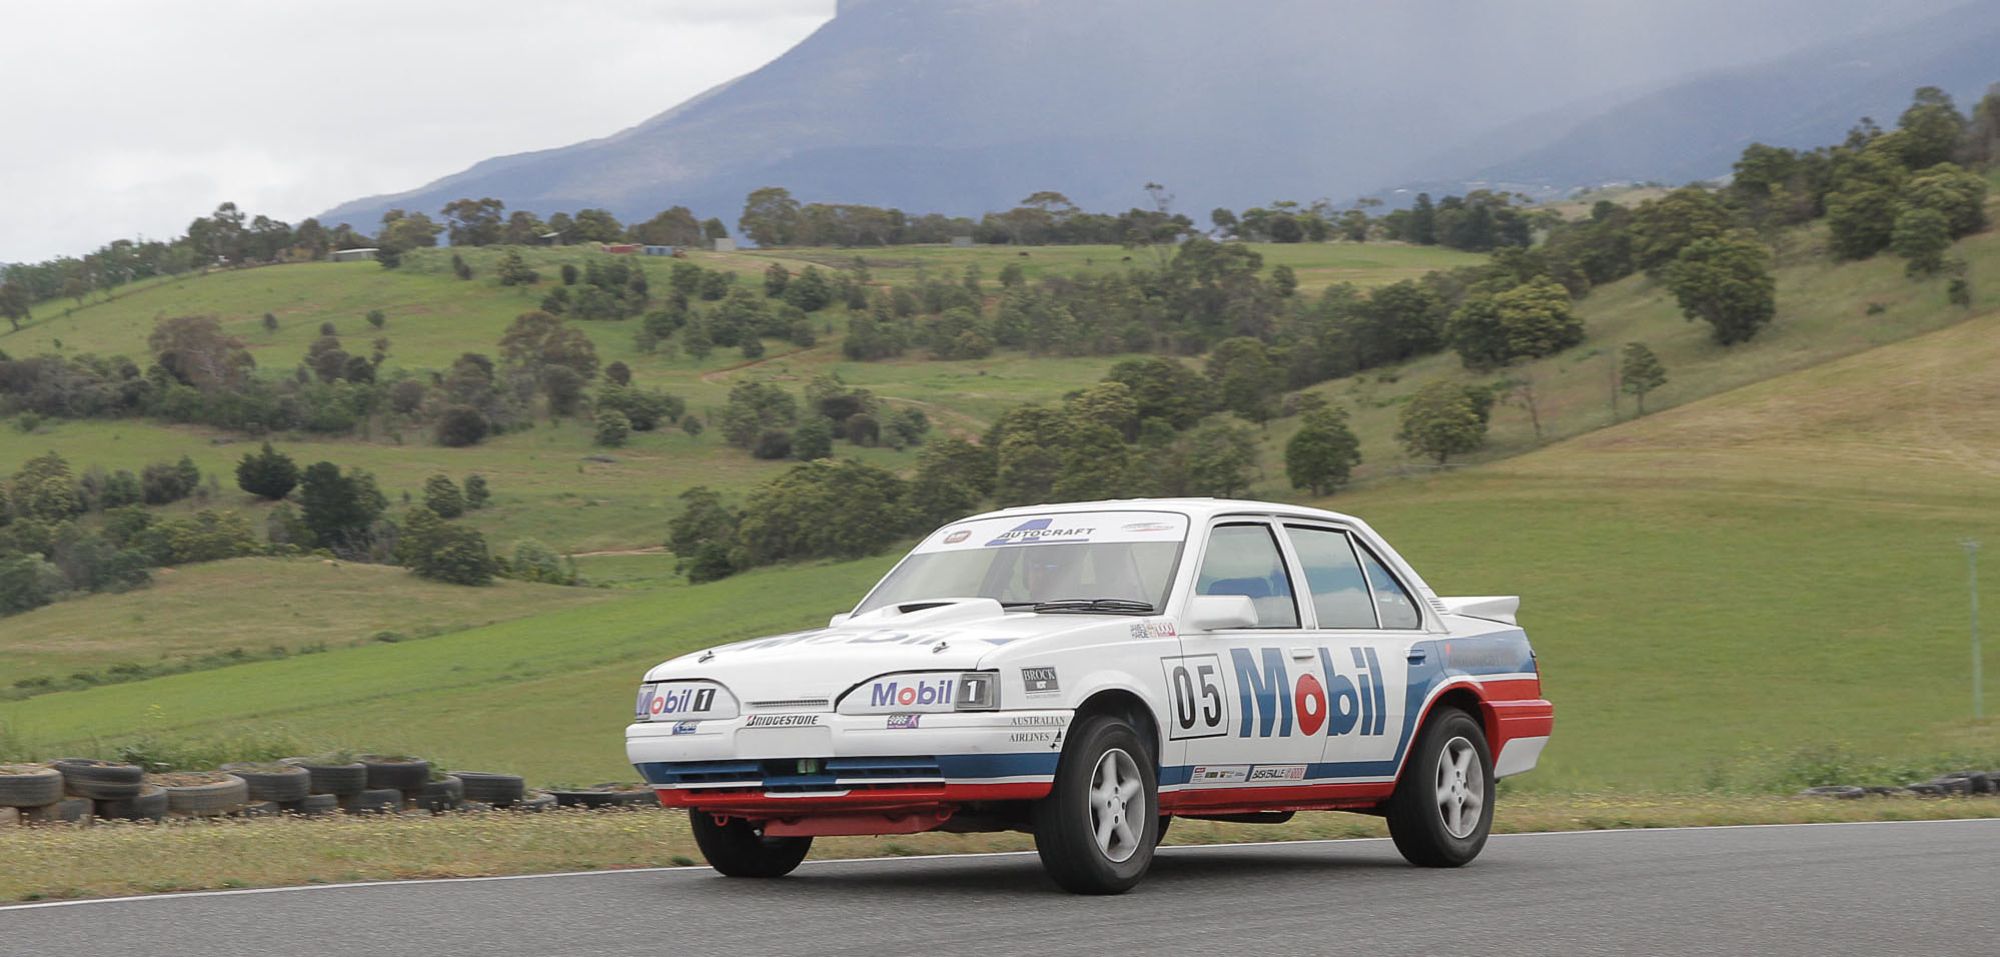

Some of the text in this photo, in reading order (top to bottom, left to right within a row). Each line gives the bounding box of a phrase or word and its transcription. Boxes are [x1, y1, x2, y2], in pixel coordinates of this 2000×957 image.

[996, 527, 1097, 539] AUTOCRAFT
[1023, 669, 1056, 680] BROCK
[871, 680, 953, 706] Mobil
[1173, 665, 1221, 729] 05
[1229, 647, 1386, 737] Mobil
[636, 689, 692, 715] Mobil
[745, 715, 818, 727] BRIDGESTONE
[1011, 716, 1066, 726] AUSTRALIAN
[1009, 732, 1050, 742] AIRLINES
